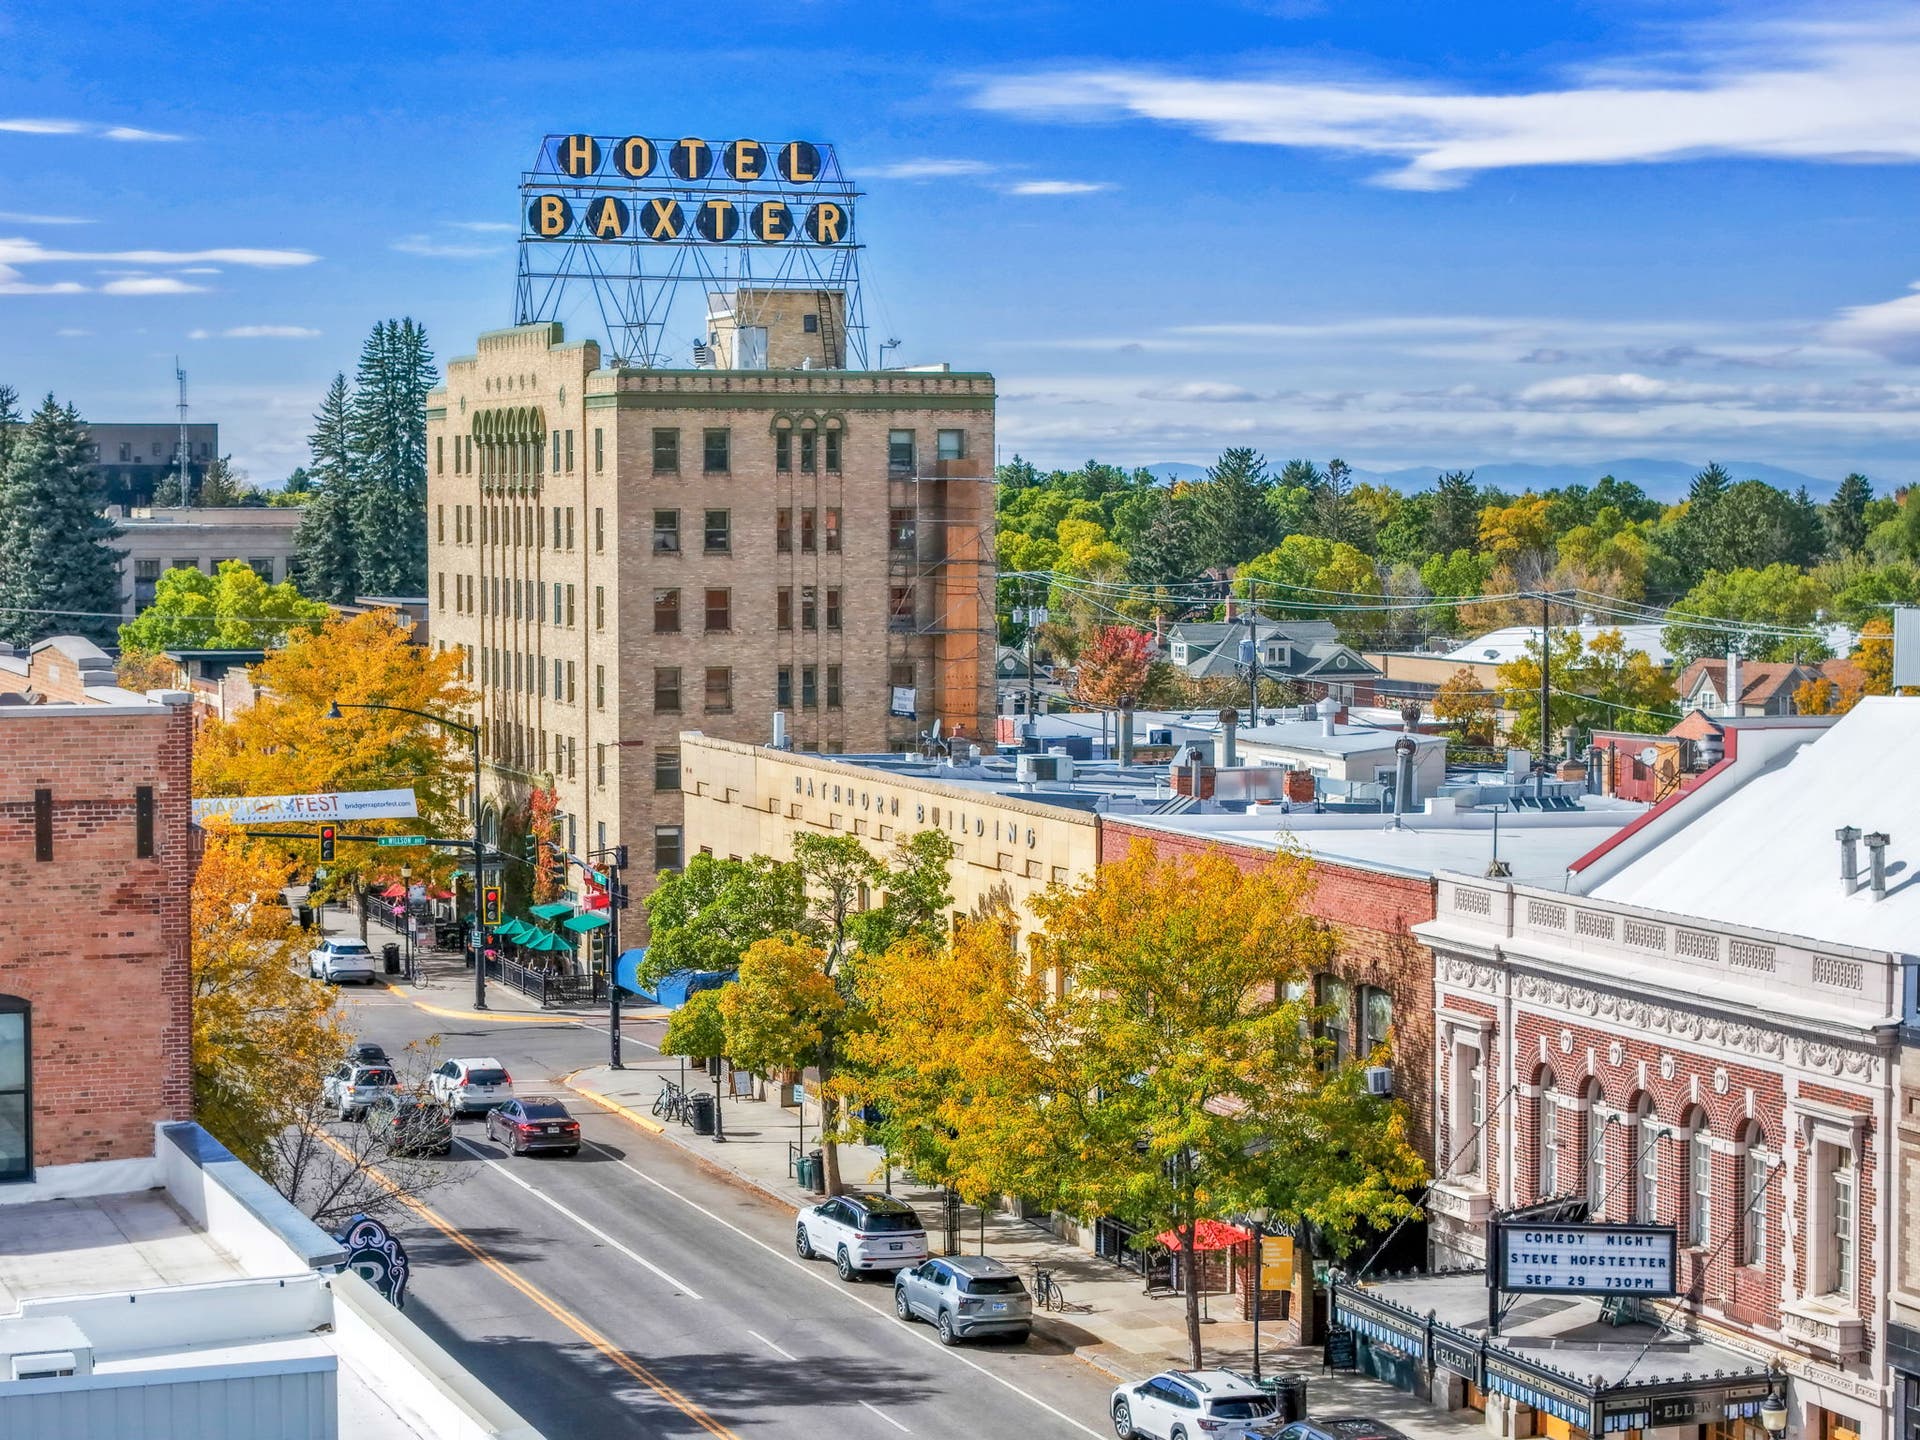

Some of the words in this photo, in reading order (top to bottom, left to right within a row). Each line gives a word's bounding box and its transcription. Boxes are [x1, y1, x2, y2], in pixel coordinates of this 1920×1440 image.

[568, 136, 814, 181] HOTEL
[540, 196, 841, 243] BAXTER
[199, 798, 283, 817] RAPTOR
[295, 795, 339, 813] FEST
[795, 776, 899, 817] HATHHORN
[916, 803, 1036, 849] BUILDING
[388, 837, 411, 845] WILLSON
[1525, 1233, 1585, 1244] COMEDY
[1607, 1235, 1654, 1247] NIGHT
[1511, 1253, 1558, 1264] STEVE
[1570, 1255, 1666, 1268] HOFSTETTER
[1526, 1274, 1552, 1285] SEP
[1567, 1276, 1585, 1286] 29
[1605, 1277, 1654, 1289] 730PM
[1440, 1349, 1468, 1370] ELLEN
[1663, 1401, 1711, 1418] ELLEN
